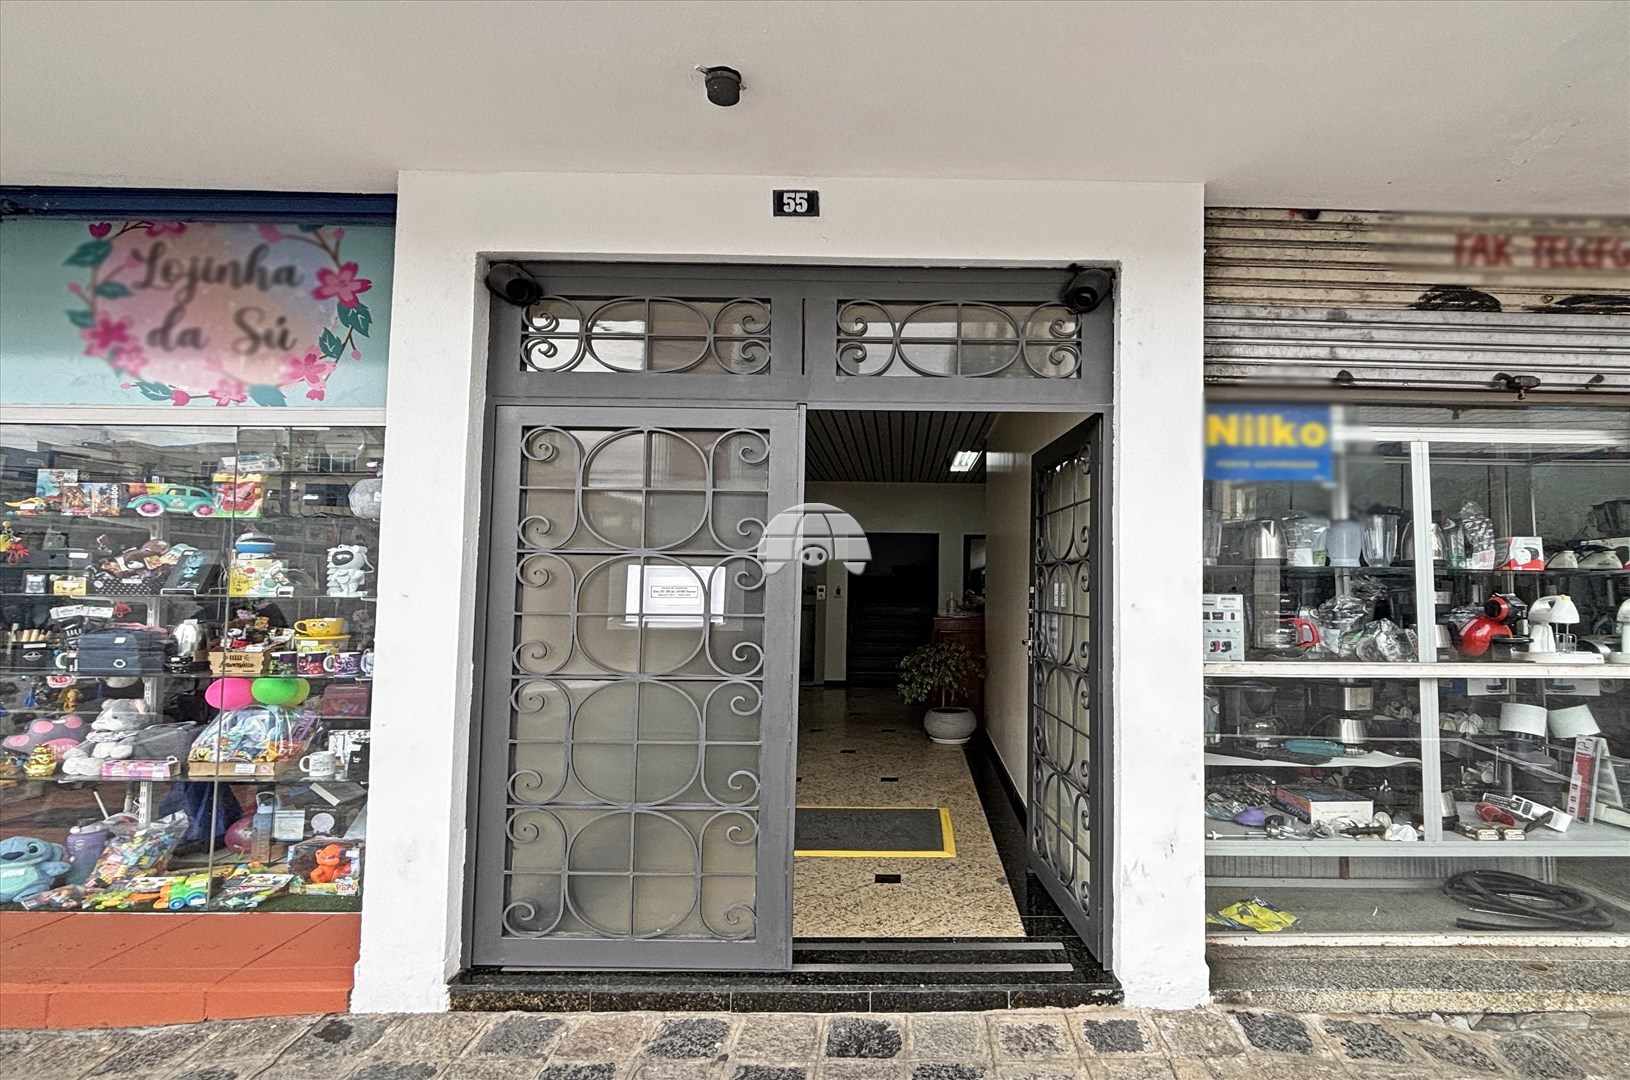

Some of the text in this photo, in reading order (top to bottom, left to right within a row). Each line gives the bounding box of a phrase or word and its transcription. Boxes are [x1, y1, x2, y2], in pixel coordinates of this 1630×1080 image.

[783, 192, 808, 213] 55
[131, 240, 305, 304] Lojinha
[146, 304, 210, 352] da
[1206, 413, 1328, 448] Nilko
